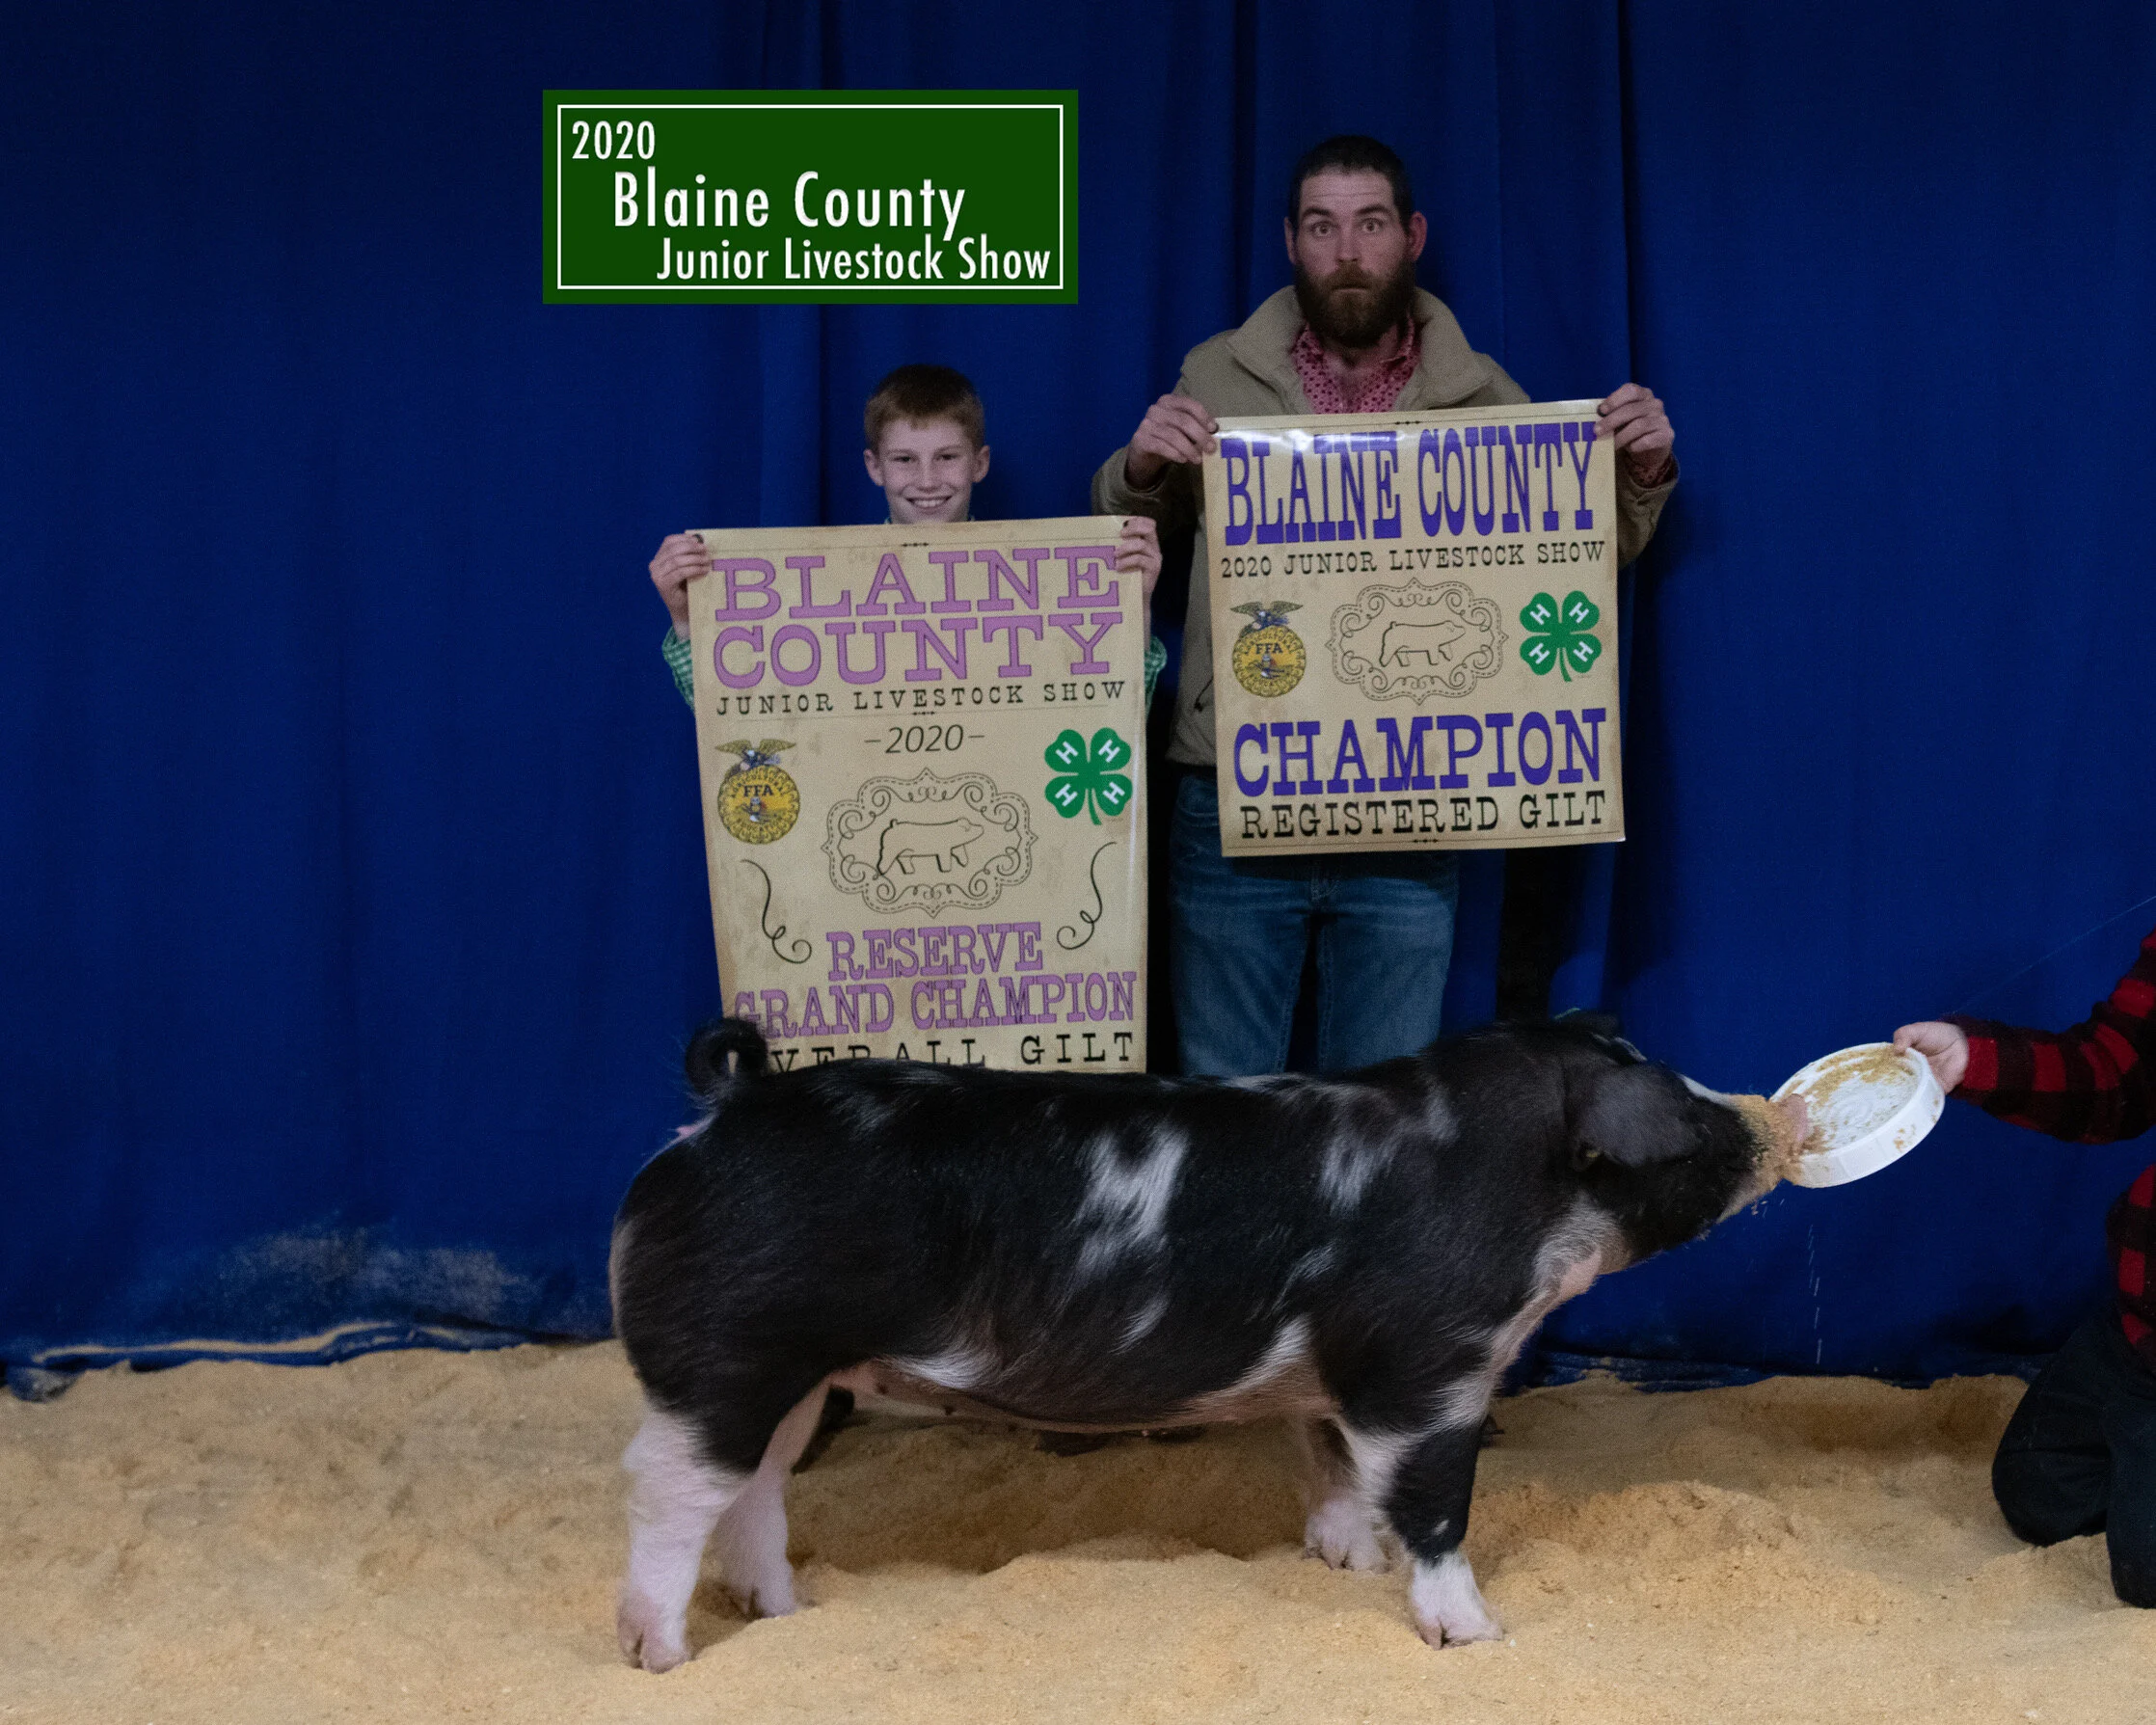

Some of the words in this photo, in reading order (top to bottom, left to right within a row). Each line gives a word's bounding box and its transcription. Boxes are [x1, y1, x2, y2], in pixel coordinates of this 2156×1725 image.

[1221, 430, 1402, 547] BLAINE
[1417, 421, 1598, 537] COUNTY
[712, 546, 1119, 622] BLAINE
[1221, 555, 1272, 579] 2020
[1284, 551, 1378, 576] JUNIOR
[1388, 544, 1525, 571] LIVESTOCK
[1537, 540, 1605, 564] SHOW
[714, 612, 1123, 689] COUNTY
[1255, 642, 1283, 655] FFA
[716, 692, 834, 716] JUNIOR
[853, 685, 1025, 710] LIVESTOCK
[1043, 681, 1125, 703] SHOW
[1233, 708, 1607, 797] CHAMPION
[743, 784, 773, 797] FFA
[1240, 795, 1499, 839] REGISTERED
[1519, 790, 1606, 829] GILT
[826, 922, 1044, 982] RESERVE
[735, 983, 895, 1039] GRAND
[910, 971, 1138, 1030] CHAMPION
[1020, 1032, 1134, 1065] GILT
